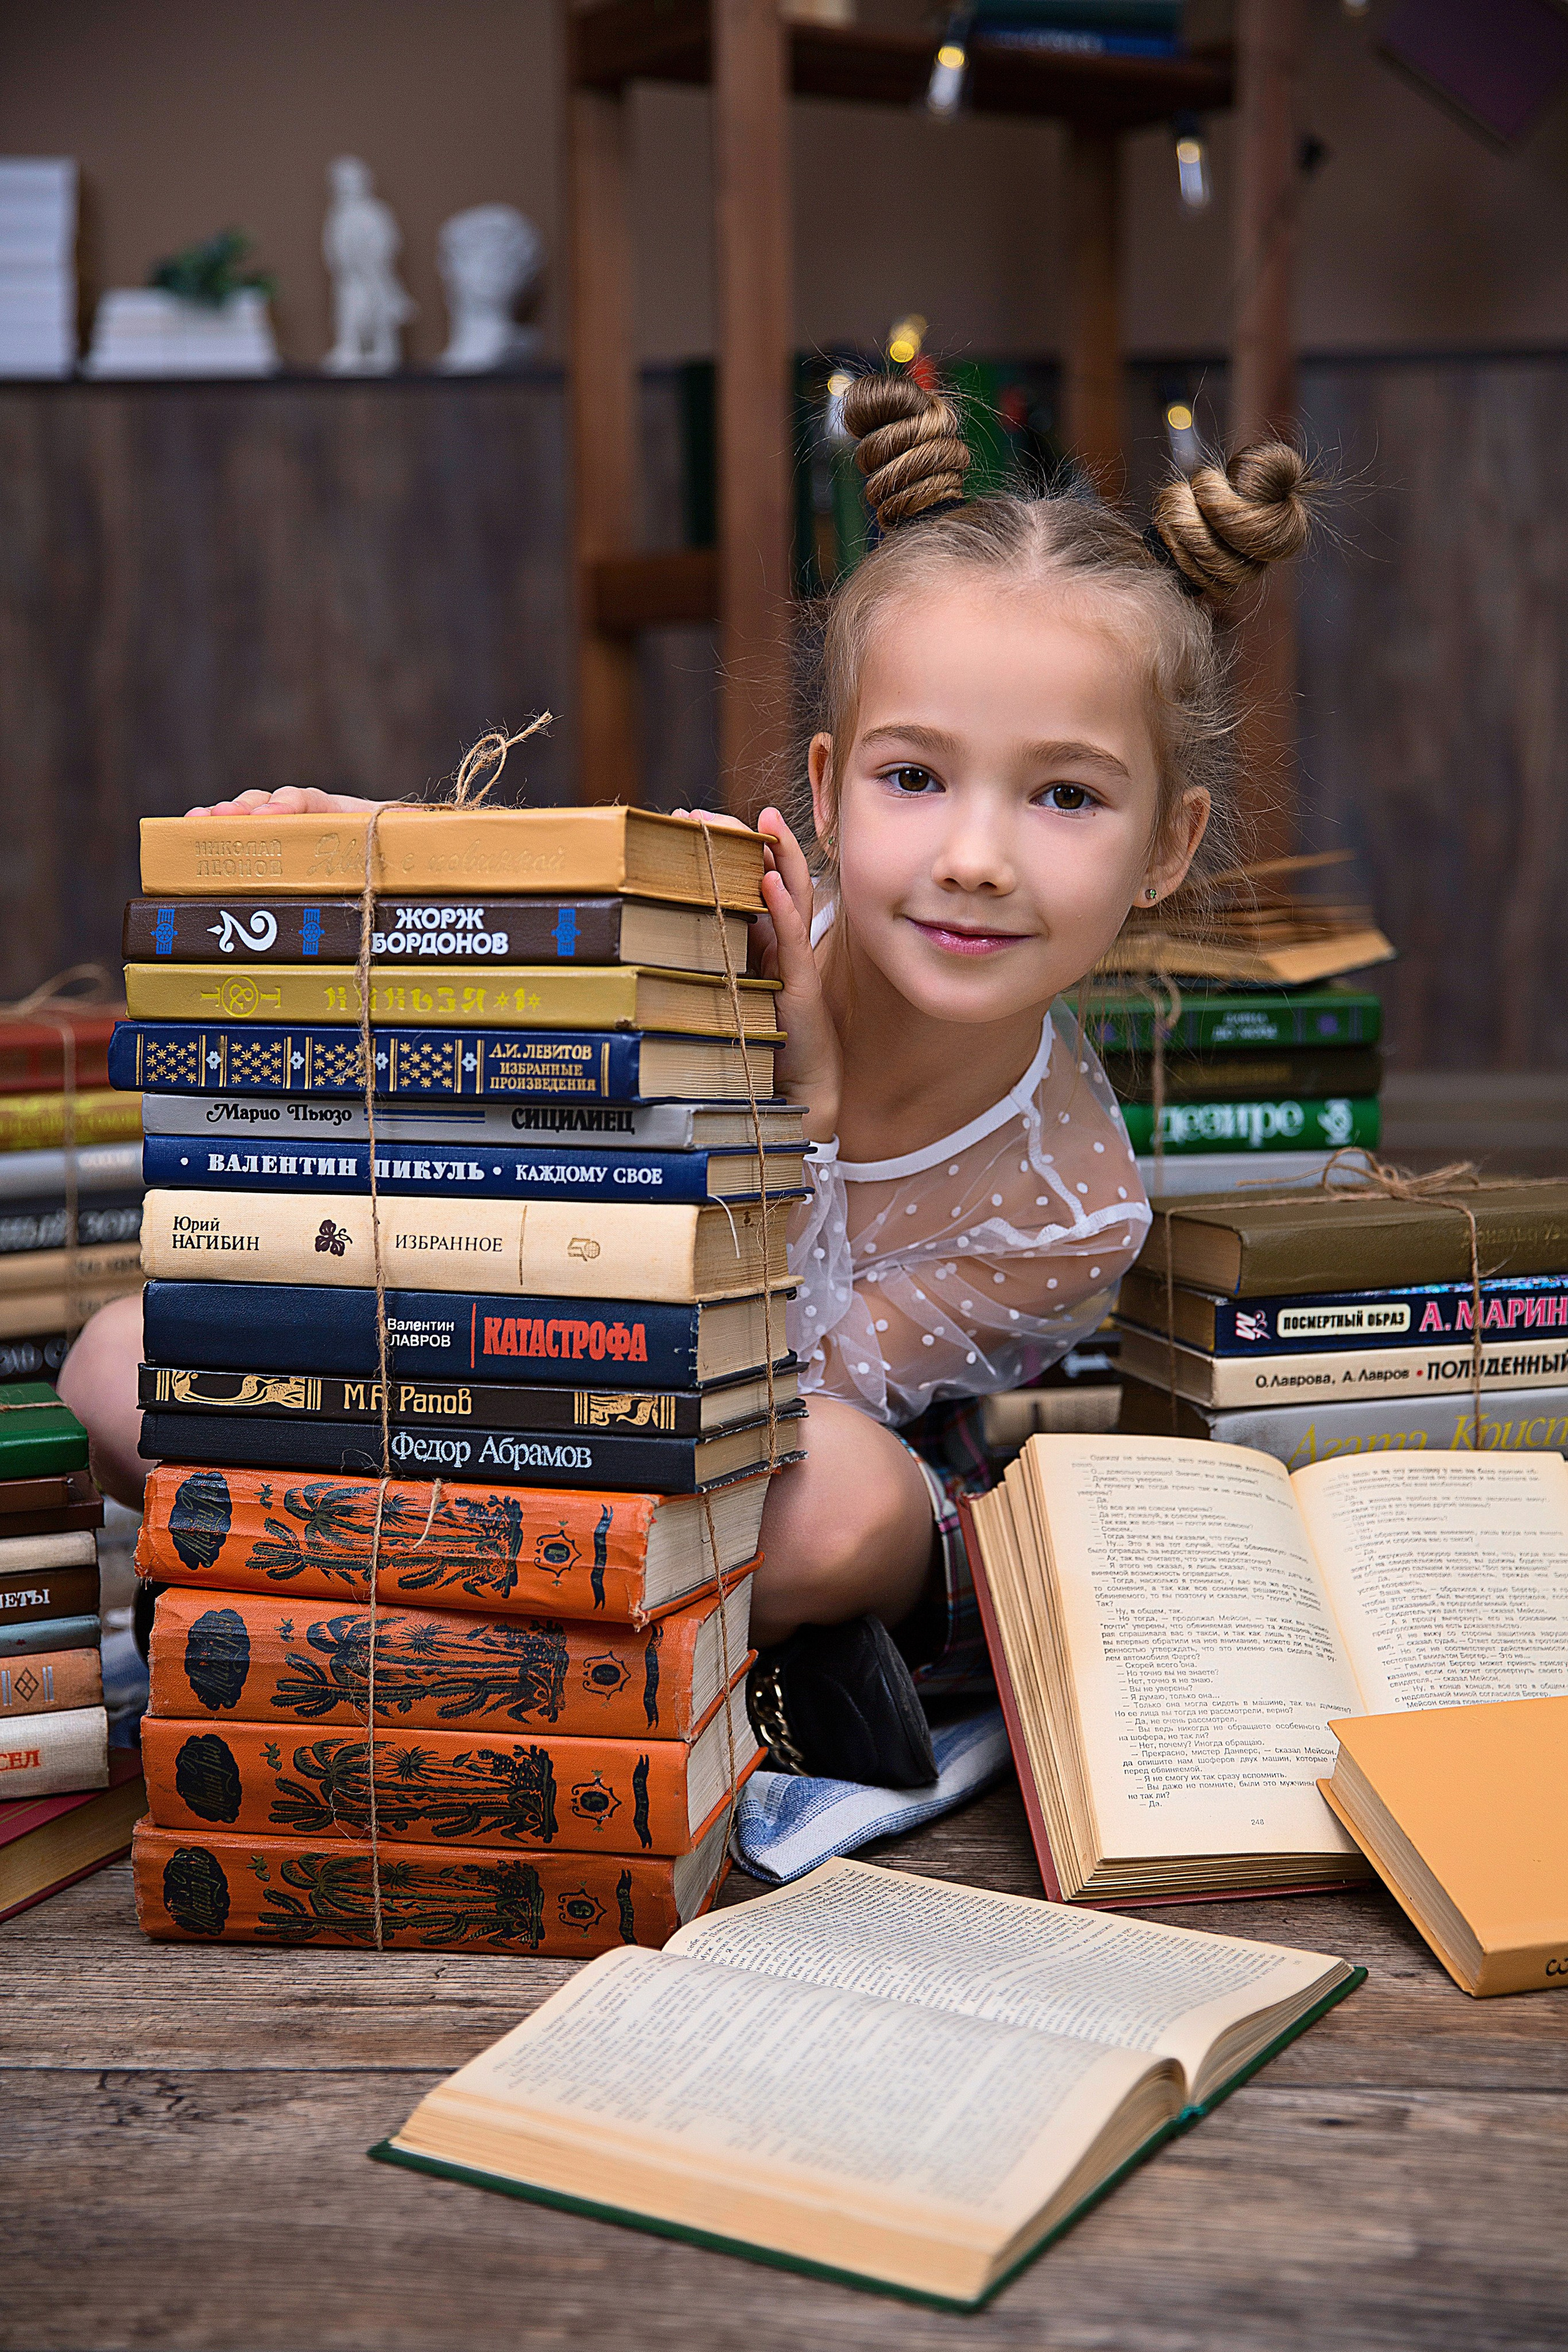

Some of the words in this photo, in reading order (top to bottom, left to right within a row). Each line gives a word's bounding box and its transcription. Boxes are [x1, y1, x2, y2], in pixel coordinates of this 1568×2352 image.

[195, 839, 282, 857] НИКОЛАЙ
[195, 859, 283, 877] ЛЕОНОВ
[394, 908, 484, 930] ЖОРЖ
[370, 932, 510, 956] БОРДОНОВ
[499, 1061, 584, 1077] ИЗБРАННЫЕ
[489, 1076, 597, 1093] ПРОИЗВЕДЕНИЯ
[206, 1104, 281, 1123] Марио
[287, 1104, 353, 1126] Пьюзо
[511, 1107, 635, 1135] СИЦИЛИЕЦ
[207, 1153, 358, 1177] ВАЛЕНТИН
[372, 1159, 485, 1180] ПИКУЛЬ
[515, 1164, 608, 1184] КАЖДОМУ
[613, 1167, 663, 1185] СВОЕ
[172, 1216, 220, 1233] Юрий
[172, 1234, 260, 1251] НАГИБИН
[394, 1234, 503, 1253] ИЗБРАННОЕ
[386, 1317, 455, 1332] Валентин
[1284, 1310, 1363, 1330] ПОСМЕРТНЫЙ
[1367, 1312, 1404, 1326] ОБРАЗ
[389, 1334, 451, 1348] ЛАВРОВ
[483, 1317, 648, 1362] КАТАСТРОФА
[399, 1385, 472, 1415] Рапов
[391, 1431, 471, 1468] Федор
[478, 1436, 593, 1471] Абрамов
[1266, 1706, 1293, 1715] верно?
[1134, 1717, 1148, 1726] Да,
[1227, 1723, 1272, 1732] обращаете
[1275, 1722, 1321, 1730] особенного
[1130, 1733, 1166, 1742] шофера,
[1139, 1741, 1156, 1750] Нет,
[1158, 1740, 1191, 1749] почему?
[1224, 1738, 1265, 1747] обращаю.
[1141, 1750, 1188, 1758] Прекрасно,
[1224, 1747, 1261, 1756] Данверс,
[1304, 1747, 1337, 1755] Мейсон.
[1197, 1756, 1235, 1765] шоферов
[1151, 1765, 1202, 1774] обвиняемой.
[1155, 1791, 1170, 1800] ли?
[1148, 1800, 1163, 1809] Да.
[575, 1903, 592, 1916] 5
[687, 1939, 700, 1951] себе
[791, 1966, 805, 1978] Как
